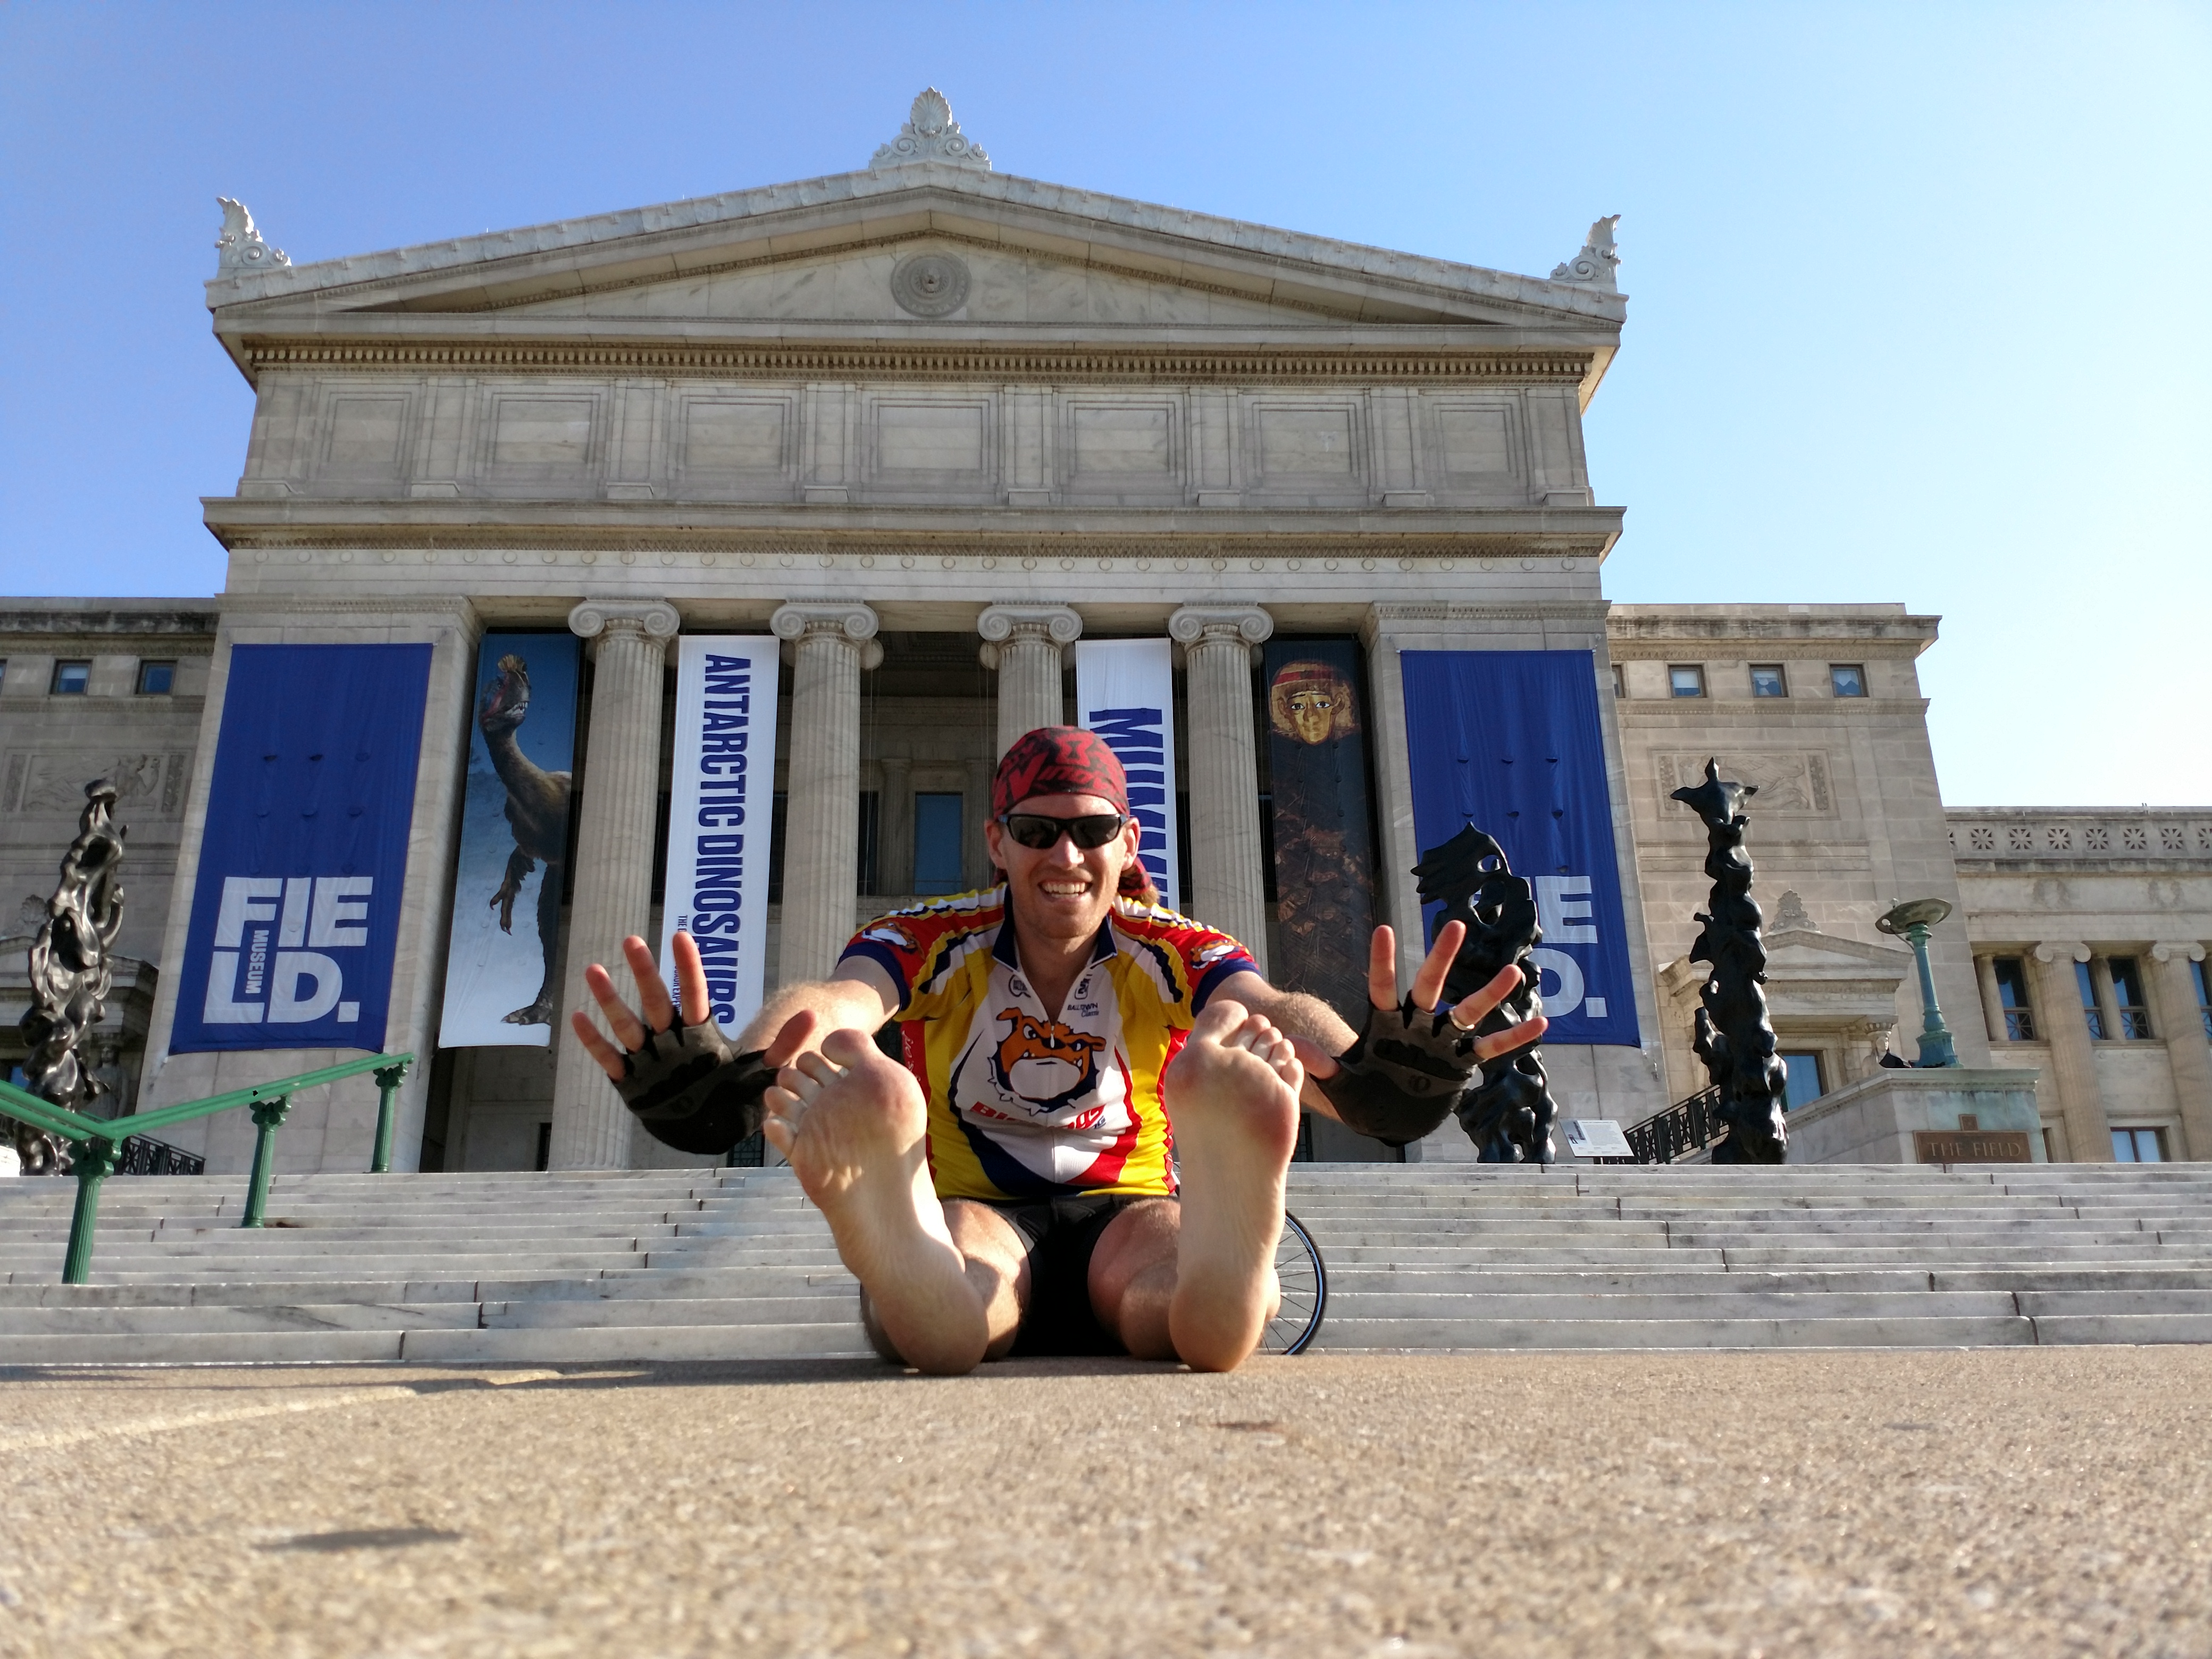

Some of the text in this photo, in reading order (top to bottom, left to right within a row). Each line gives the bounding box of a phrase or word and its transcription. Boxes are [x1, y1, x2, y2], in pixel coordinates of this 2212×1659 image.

[692, 655, 750, 1023] ANTARCTIC DINOSAURS
[678, 915, 688, 927] THE
[245, 930, 270, 994] MUSEUM
[1928, 1143, 2021, 1157] THE FIELD
